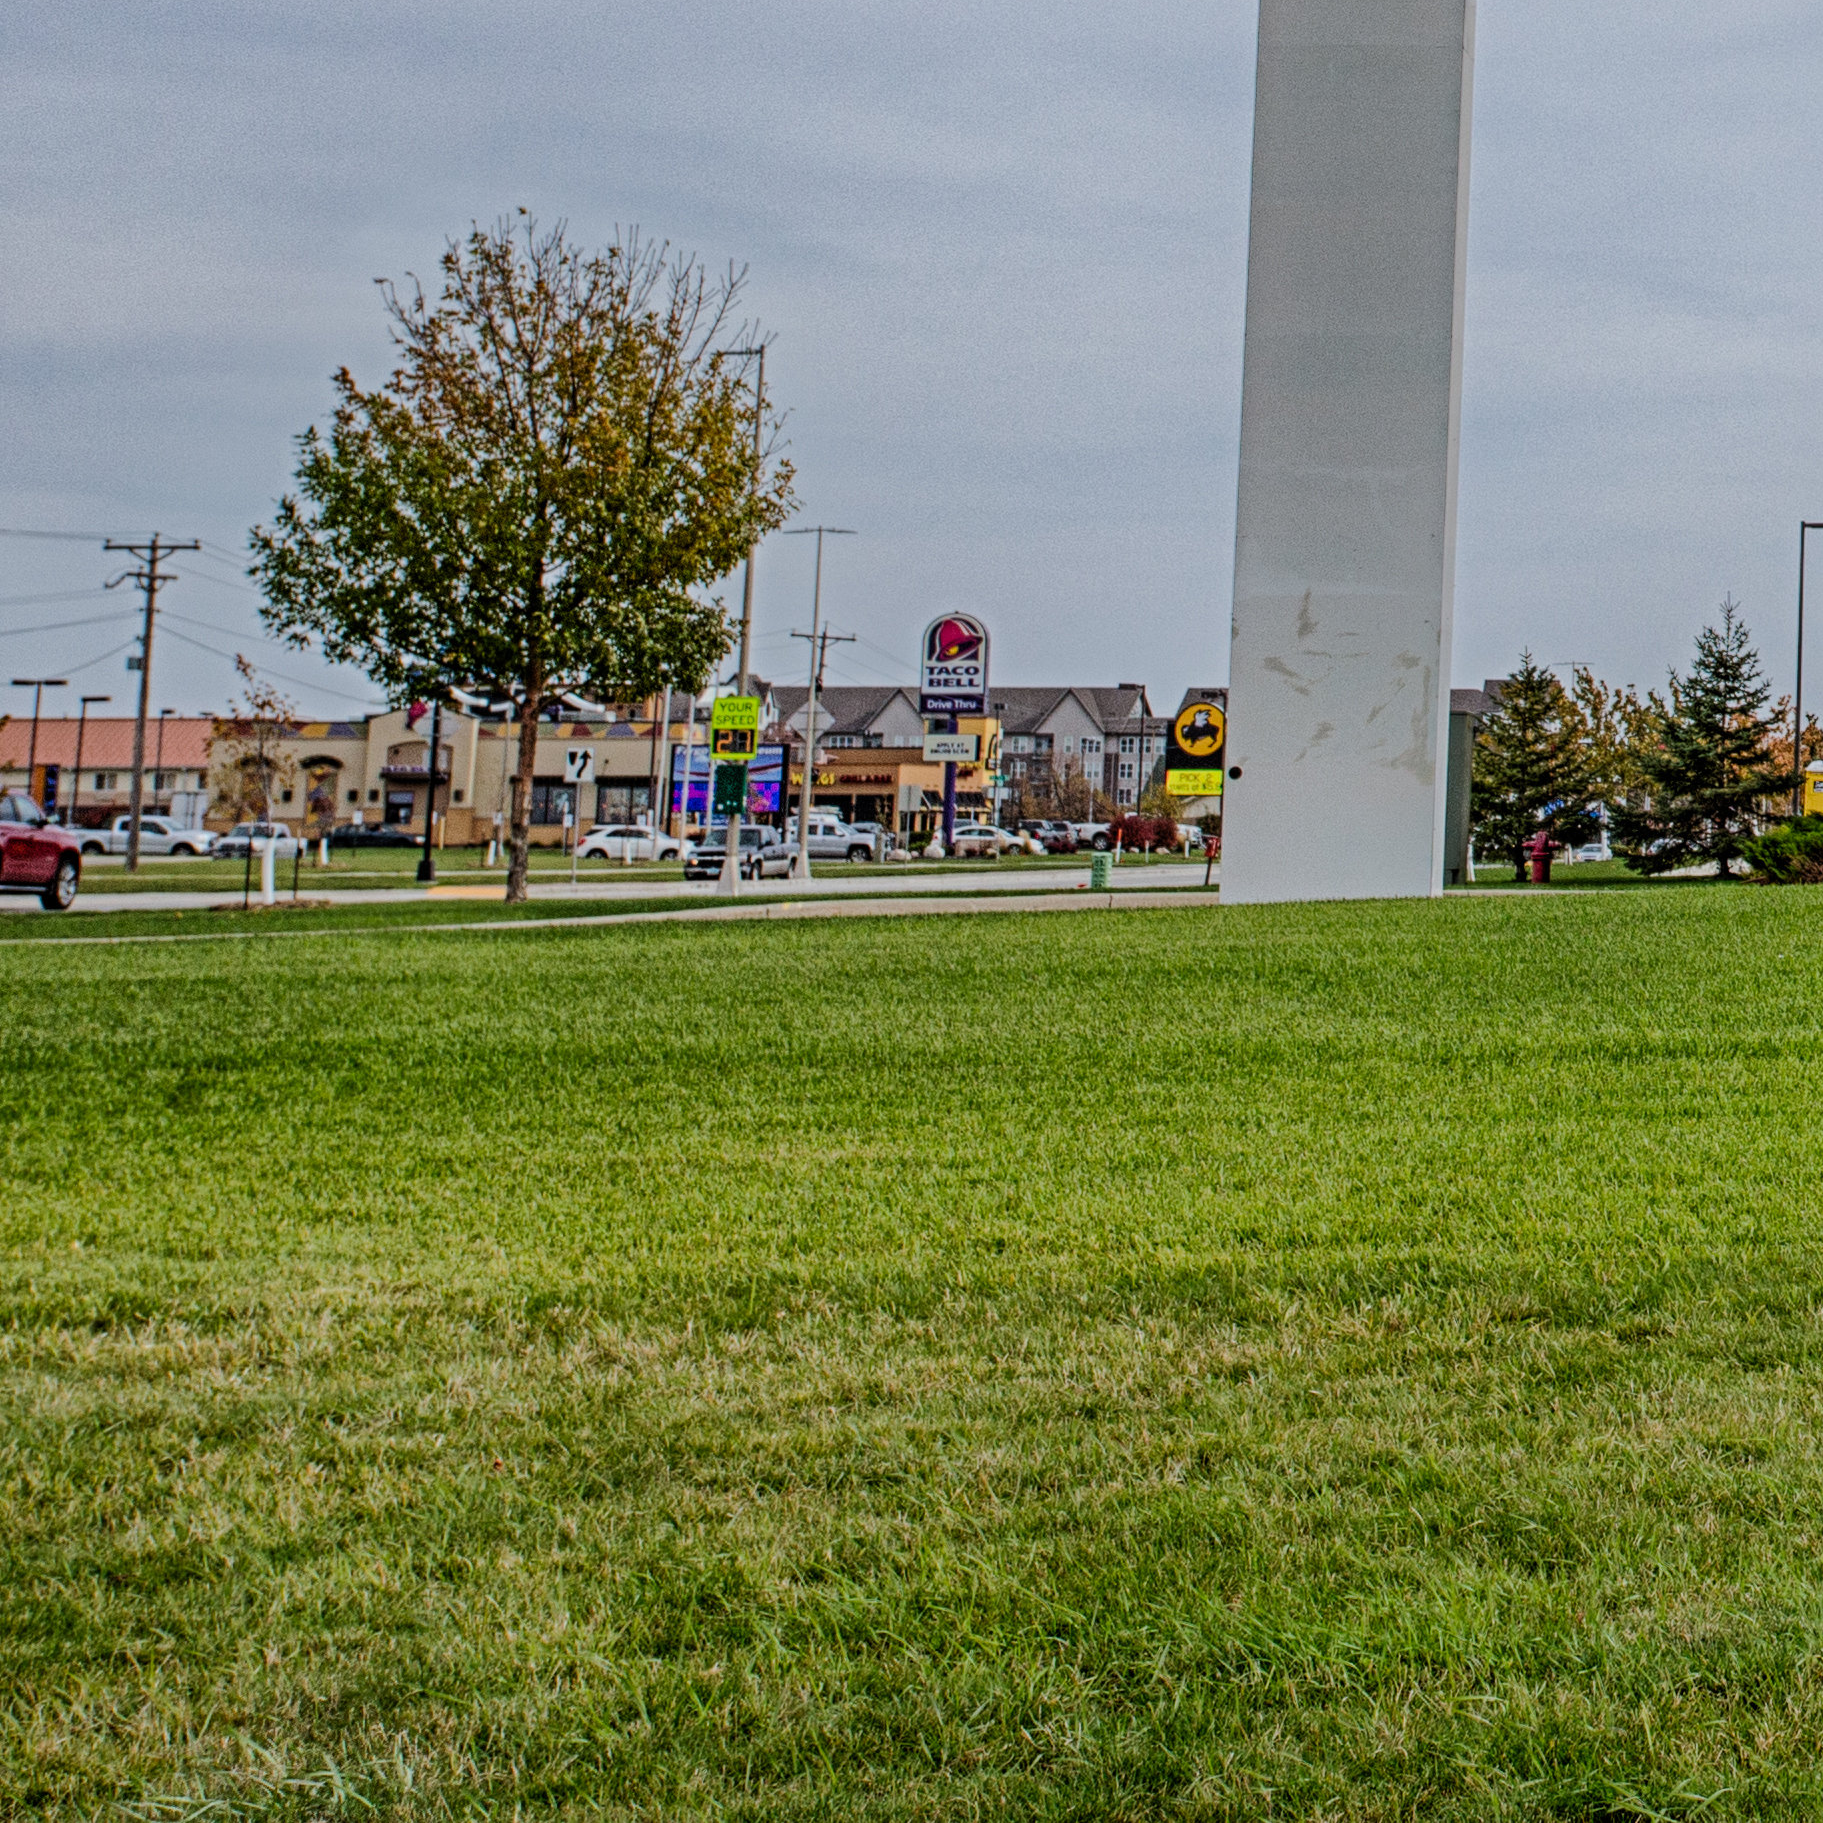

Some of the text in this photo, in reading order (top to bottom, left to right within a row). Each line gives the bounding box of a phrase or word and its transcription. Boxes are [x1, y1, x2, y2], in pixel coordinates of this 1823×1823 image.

[925, 665, 980, 676] TACO
[928, 678, 980, 687] BELL
[719, 702, 753, 712] YOUR
[927, 698, 976, 709] Drive Thru
[716, 715, 755, 725] SPEED
[791, 772, 835, 786] WGS
